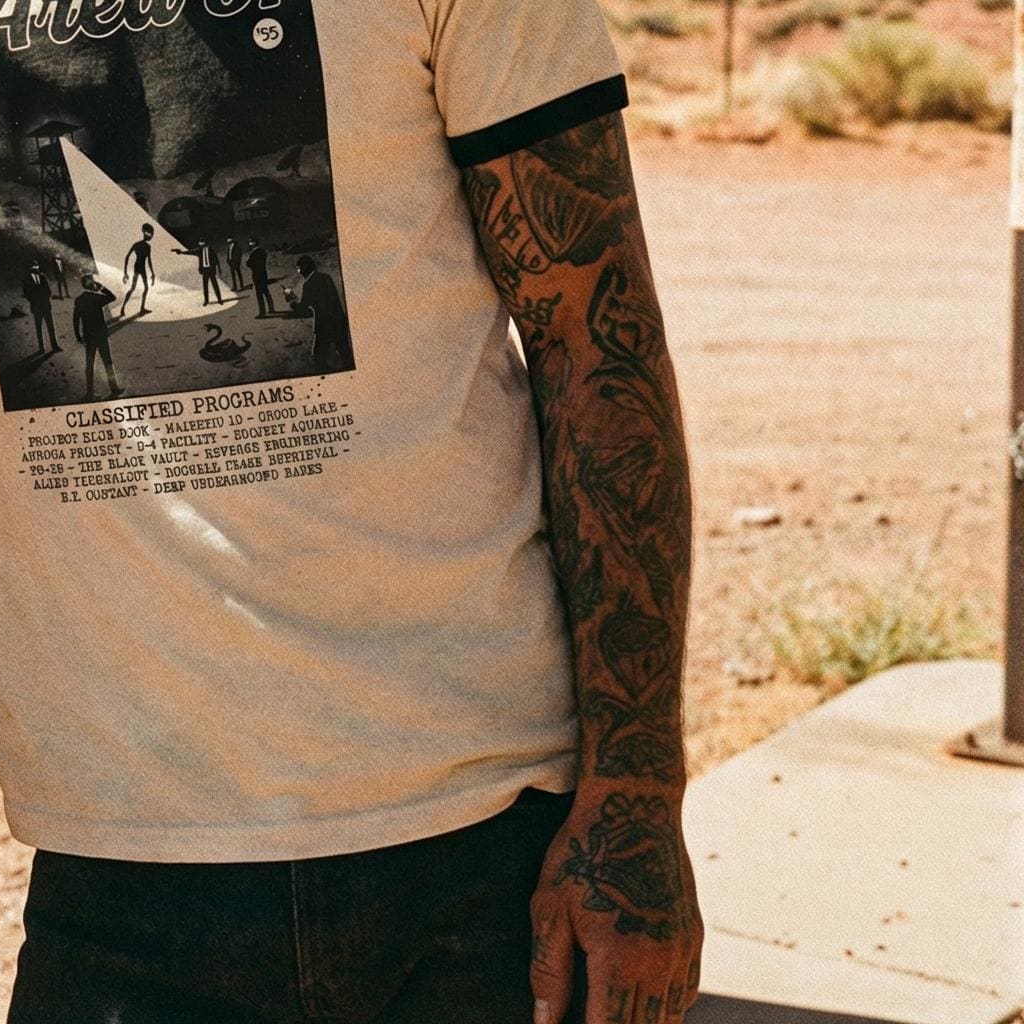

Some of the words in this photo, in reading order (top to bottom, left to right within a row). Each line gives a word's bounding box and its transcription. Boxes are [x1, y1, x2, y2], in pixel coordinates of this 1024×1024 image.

[66, 400, 184, 428] CLASSIFIED
[193, 386, 295, 414] PROGRAMS
[150, 451, 188, 464] VAULT
